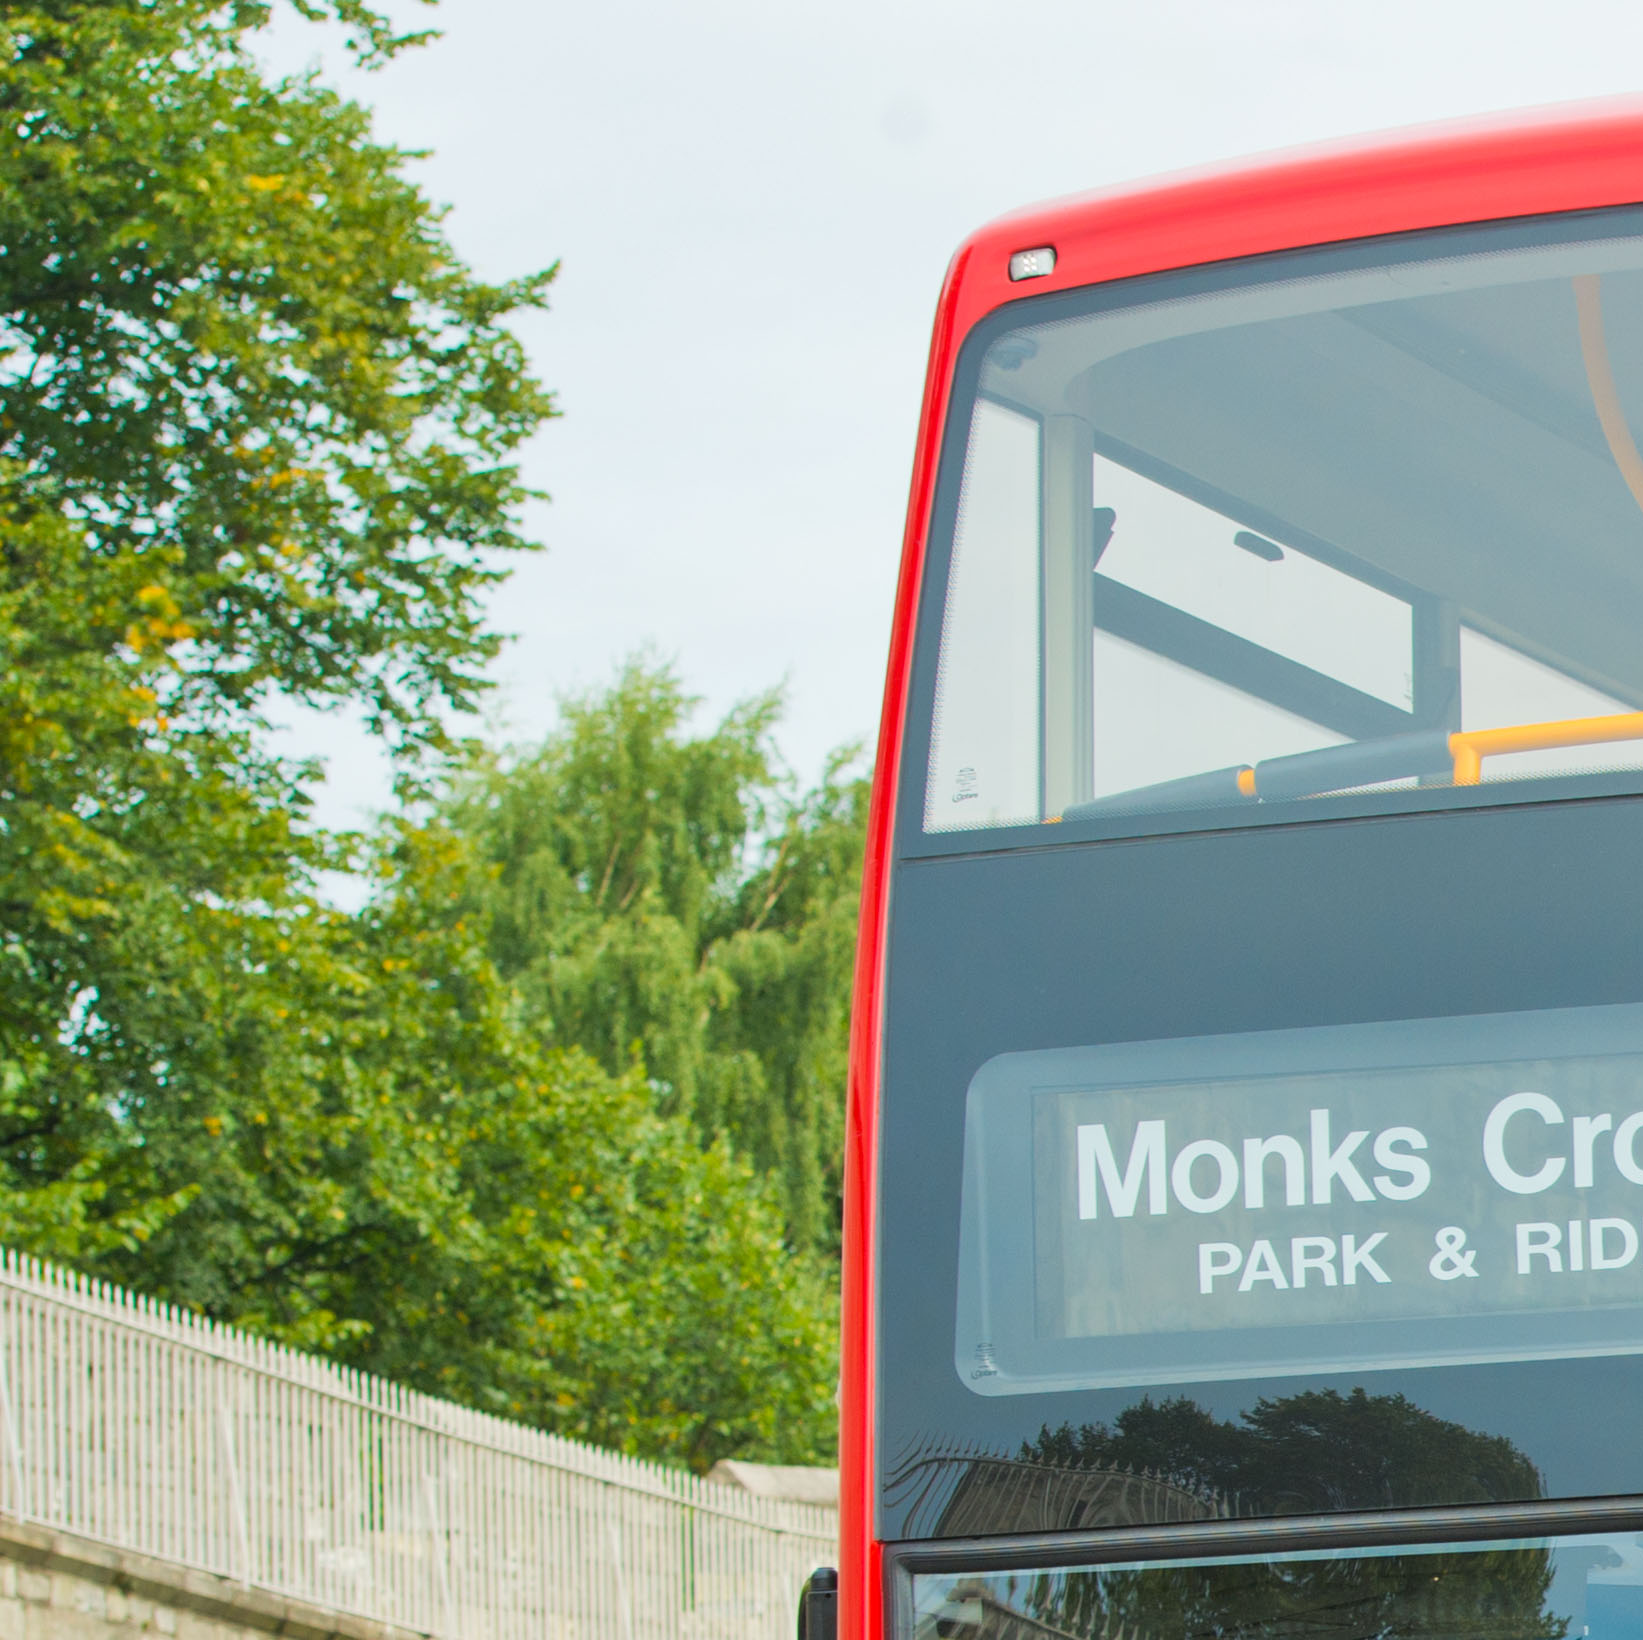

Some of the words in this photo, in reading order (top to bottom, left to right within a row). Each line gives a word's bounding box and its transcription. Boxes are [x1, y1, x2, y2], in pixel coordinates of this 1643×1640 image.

[1076, 1108, 1432, 1221] Monks
[1198, 1231, 1392, 1295] PARK
[1428, 1225, 1480, 1282] &
